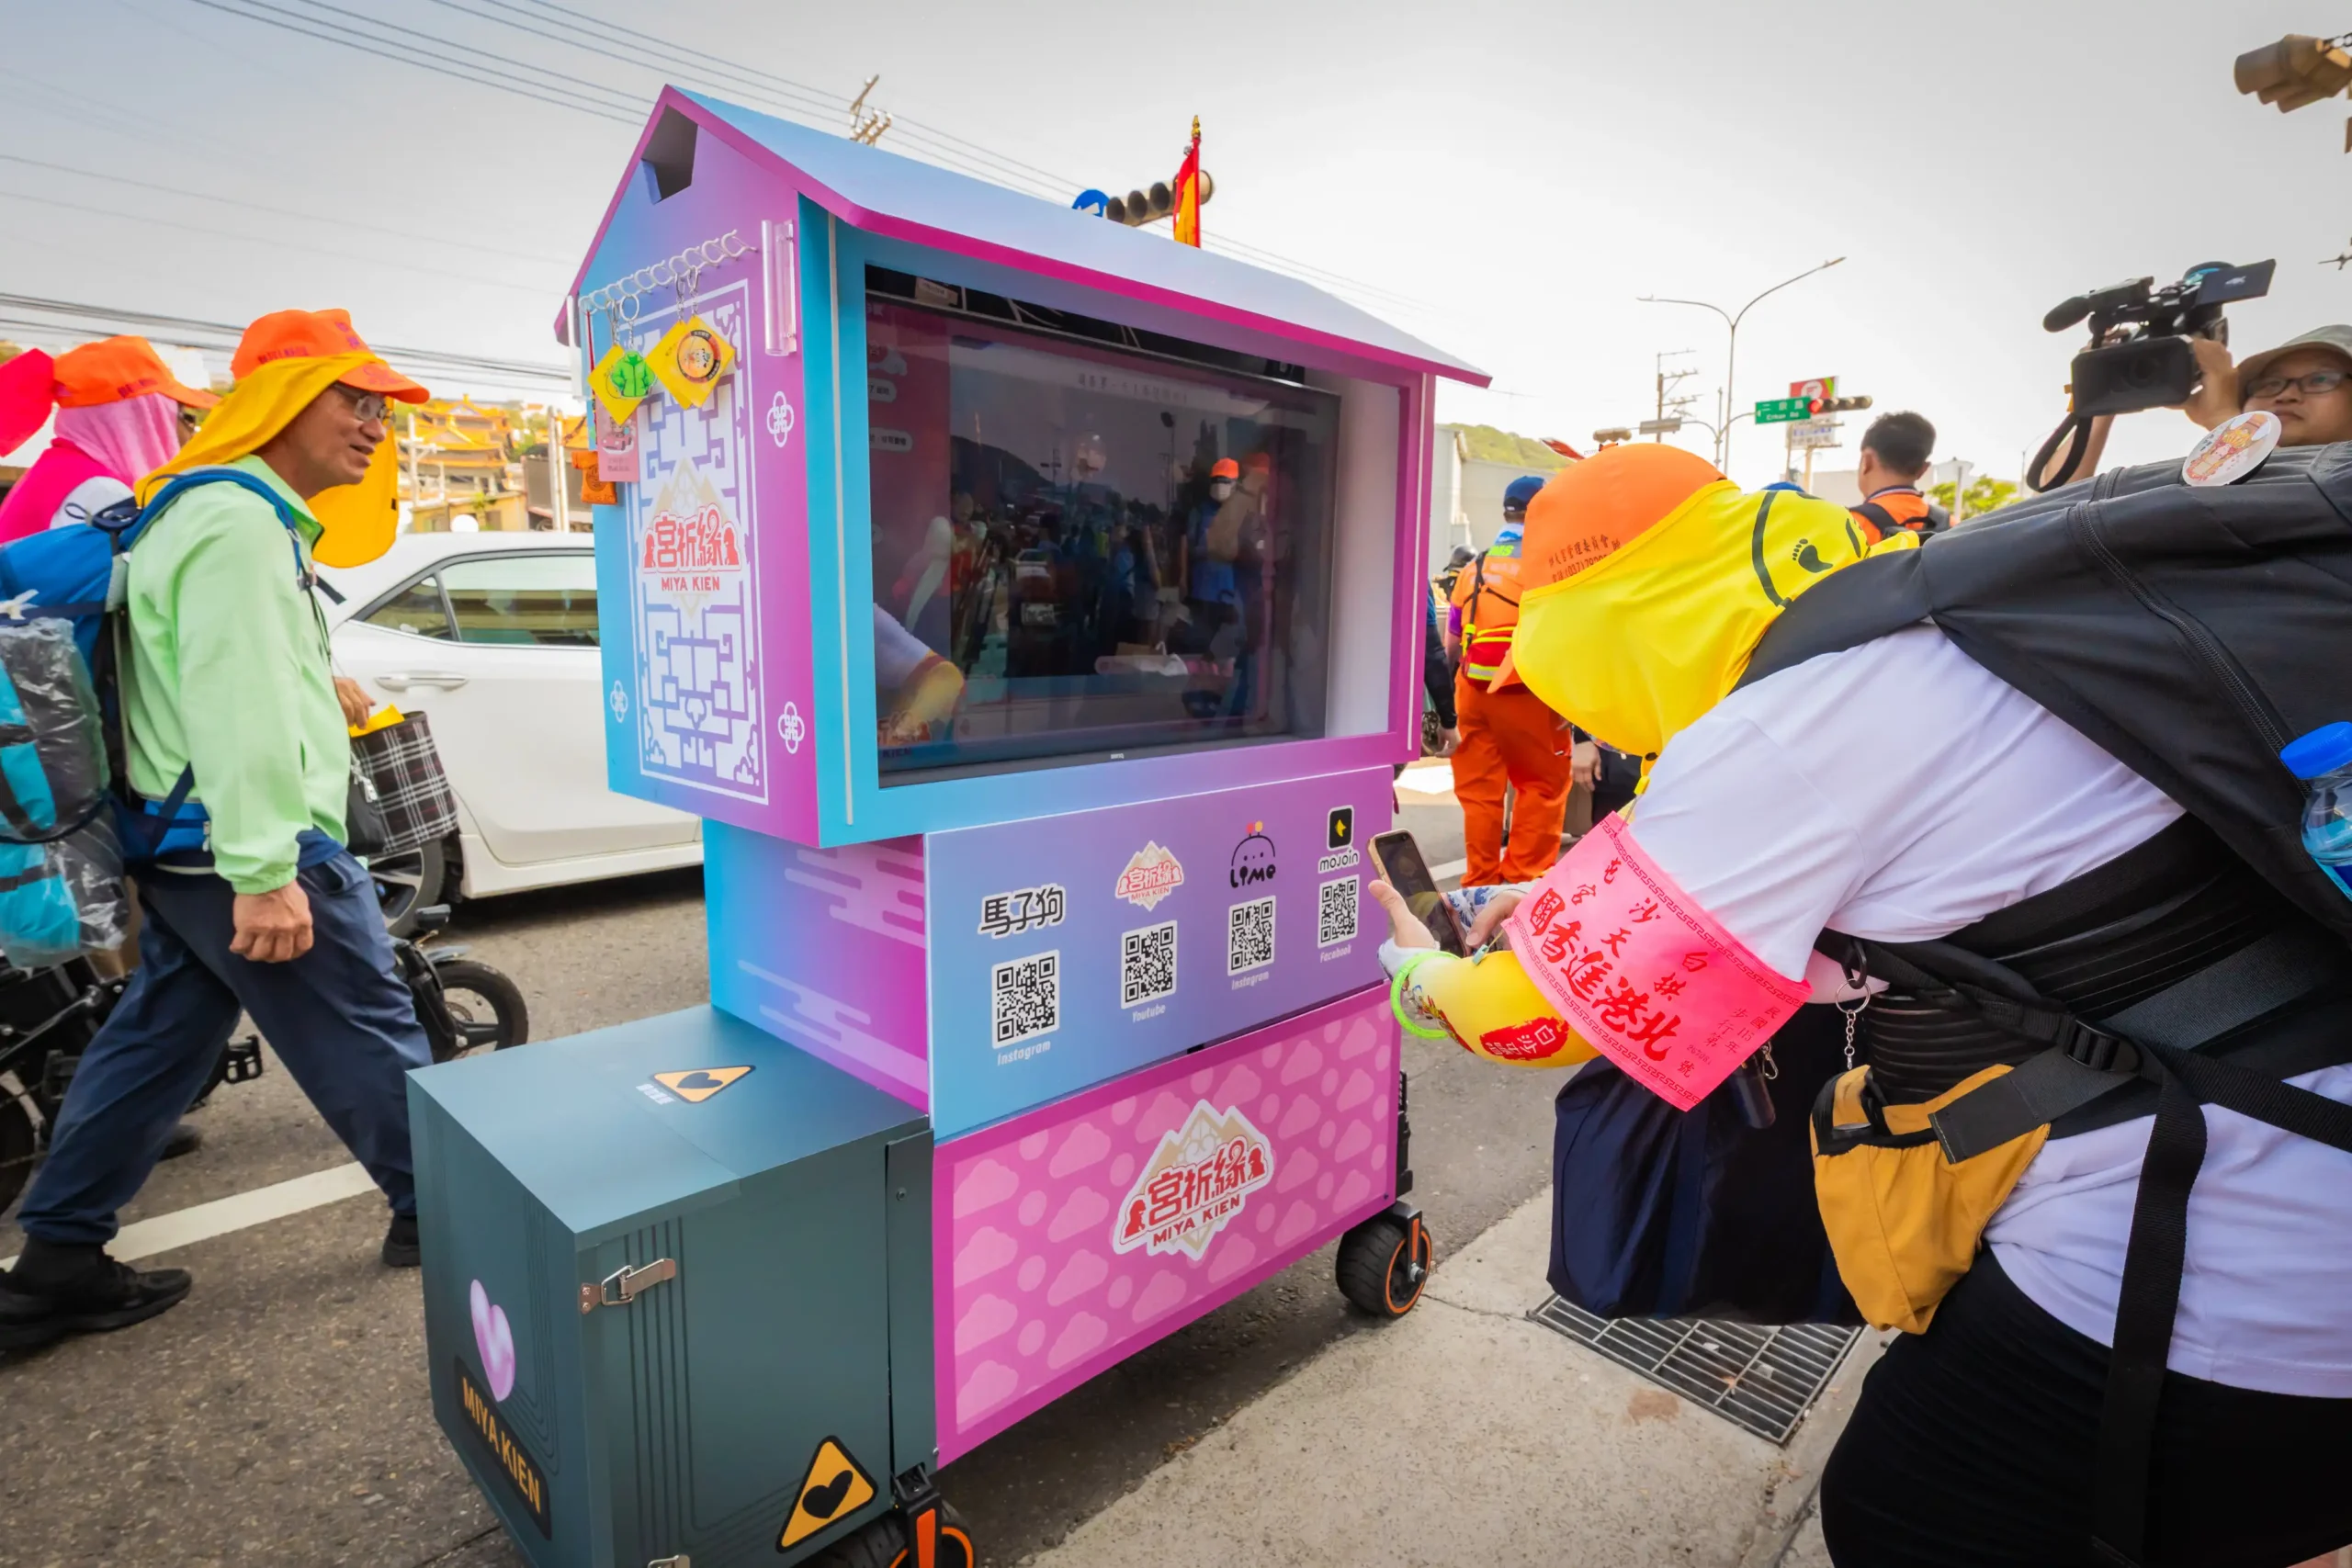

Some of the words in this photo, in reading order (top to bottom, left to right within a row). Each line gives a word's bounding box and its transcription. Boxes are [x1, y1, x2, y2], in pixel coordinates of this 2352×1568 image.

[662, 577, 688, 592] MIYA
[692, 576, 720, 592] KIEN
[1131, 891, 1151, 901] MIYA
[1152, 886, 1170, 897] KIEN
[1232, 971, 1270, 990] Instagram
[1132, 1004, 1167, 1023] Youtube
[997, 1040, 1052, 1066] Instagram
[1148, 1140, 1246, 1225] 宮祈緣
[1153, 1217, 1195, 1247] MIYA
[1203, 1194, 1240, 1223] KIEN
[463, 1376, 499, 1453] MIYA
[501, 1430, 541, 1514] KIEN
